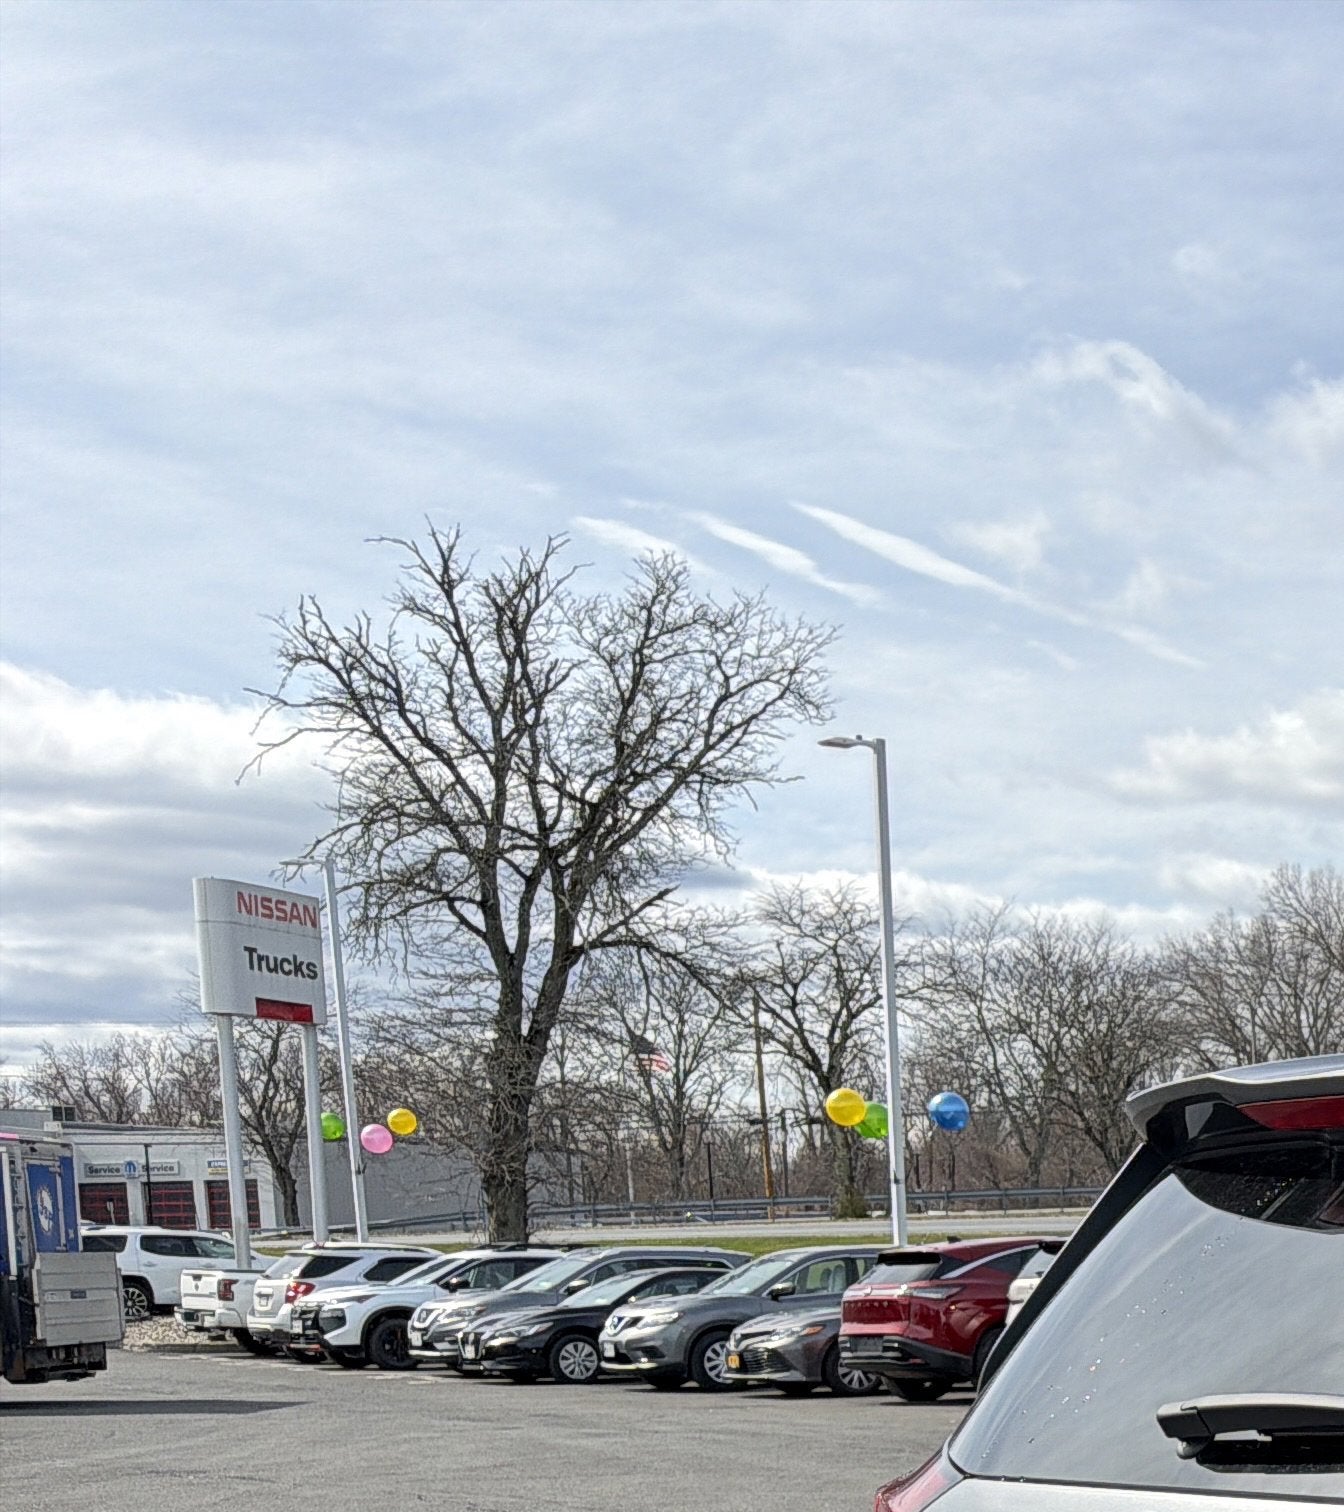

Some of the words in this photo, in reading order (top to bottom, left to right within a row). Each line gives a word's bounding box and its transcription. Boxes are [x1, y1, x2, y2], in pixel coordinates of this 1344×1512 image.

[236, 890, 318, 929] NISSAN
[243, 945, 319, 980] Trucks
[87, 1164, 121, 1175] Service
[141, 1164, 175, 1173] Srvice
